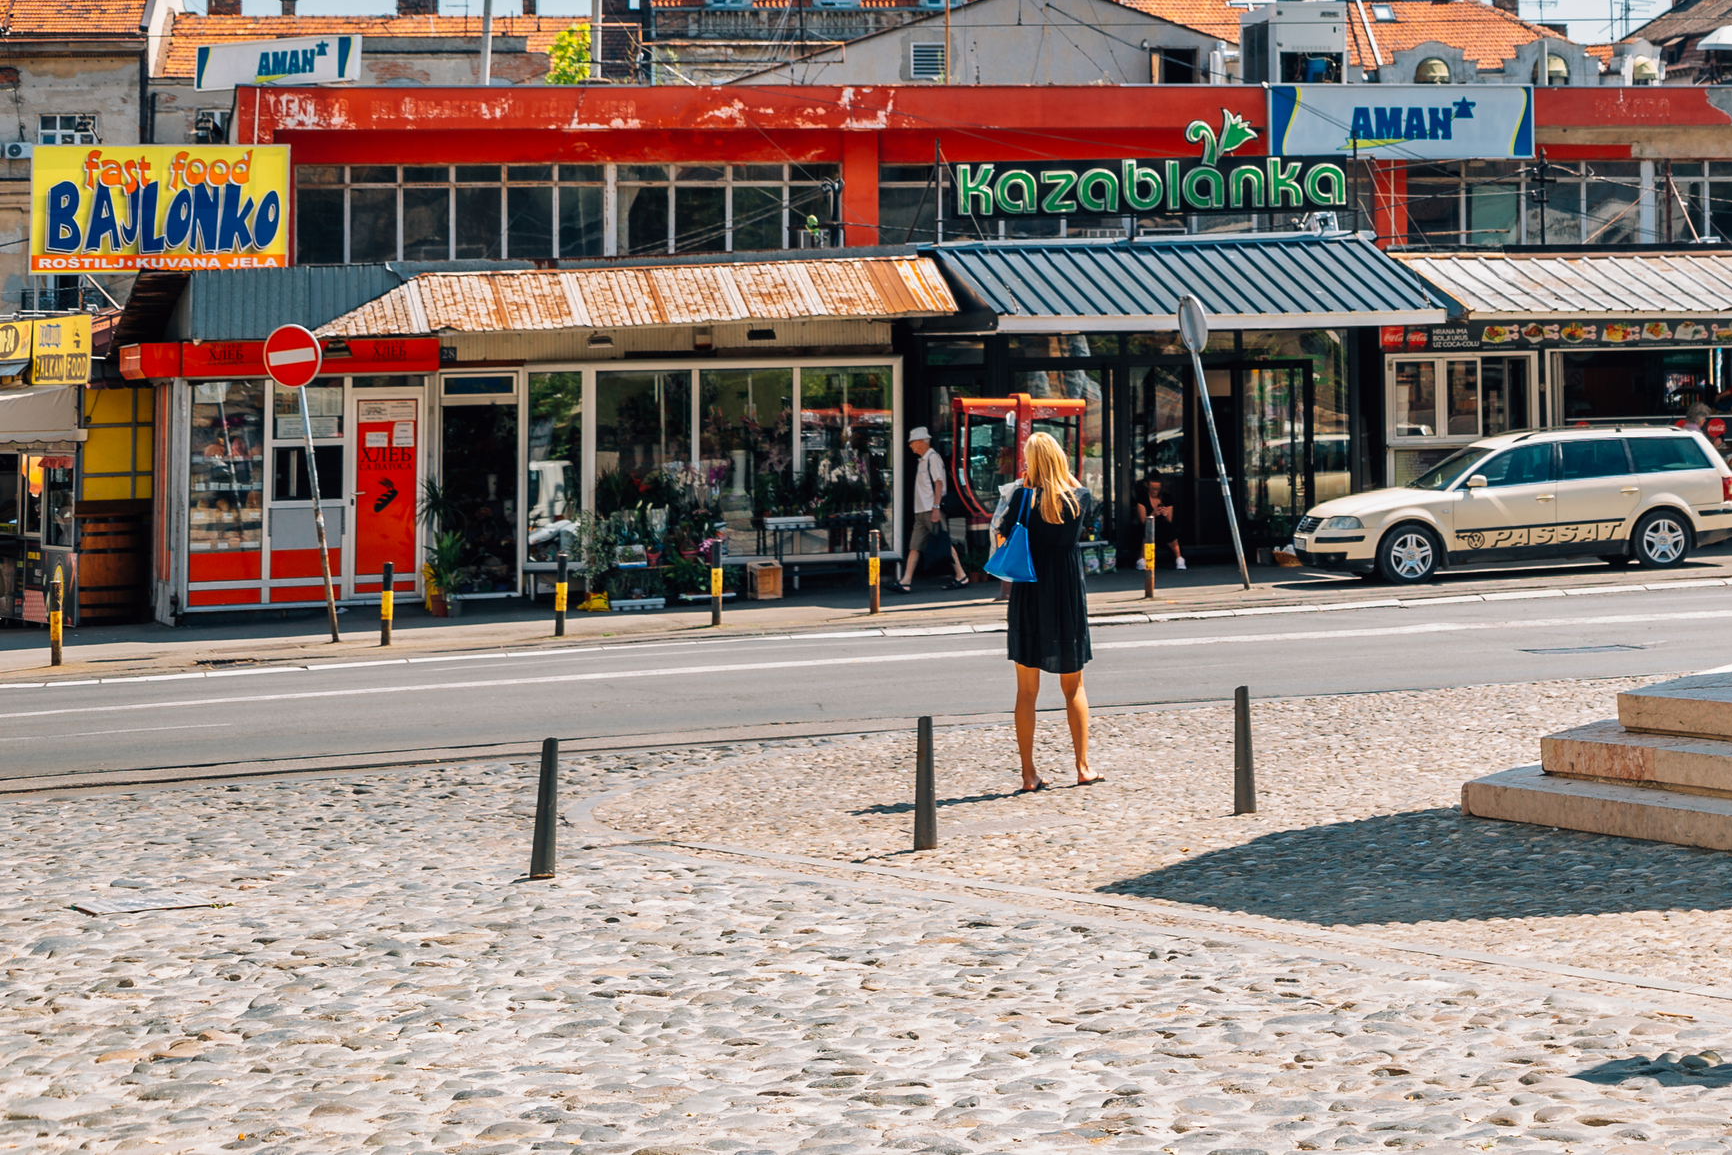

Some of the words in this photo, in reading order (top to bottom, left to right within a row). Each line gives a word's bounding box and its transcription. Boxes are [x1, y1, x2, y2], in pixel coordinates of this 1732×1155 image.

[257, 49, 316, 75] AMAN
[1351, 107, 1452, 139] AMAN
[84, 150, 151, 194] fast
[169, 149, 253, 191] food
[956, 157, 1347, 216] Kazablanka
[46, 180, 281, 255] BAJLONKO
[38, 255, 125, 269] ROŠTILJ
[136, 257, 220, 269] KUVANA
[227, 257, 278, 268] JELA
[372, 346, 407, 356] ХЛЕБ
[441, 349, 456, 359] 28
[1442, 340, 1480, 348] COCA-COLU
[208, 349, 244, 361] ХЛЕБ
[67, 354, 88, 379] FOOD
[360, 447, 412, 462] ХЛЕБ
[359, 463, 371, 471] СА
[374, 462, 412, 471] ПАТОСА
[1490, 522, 1622, 548] PASSAT
